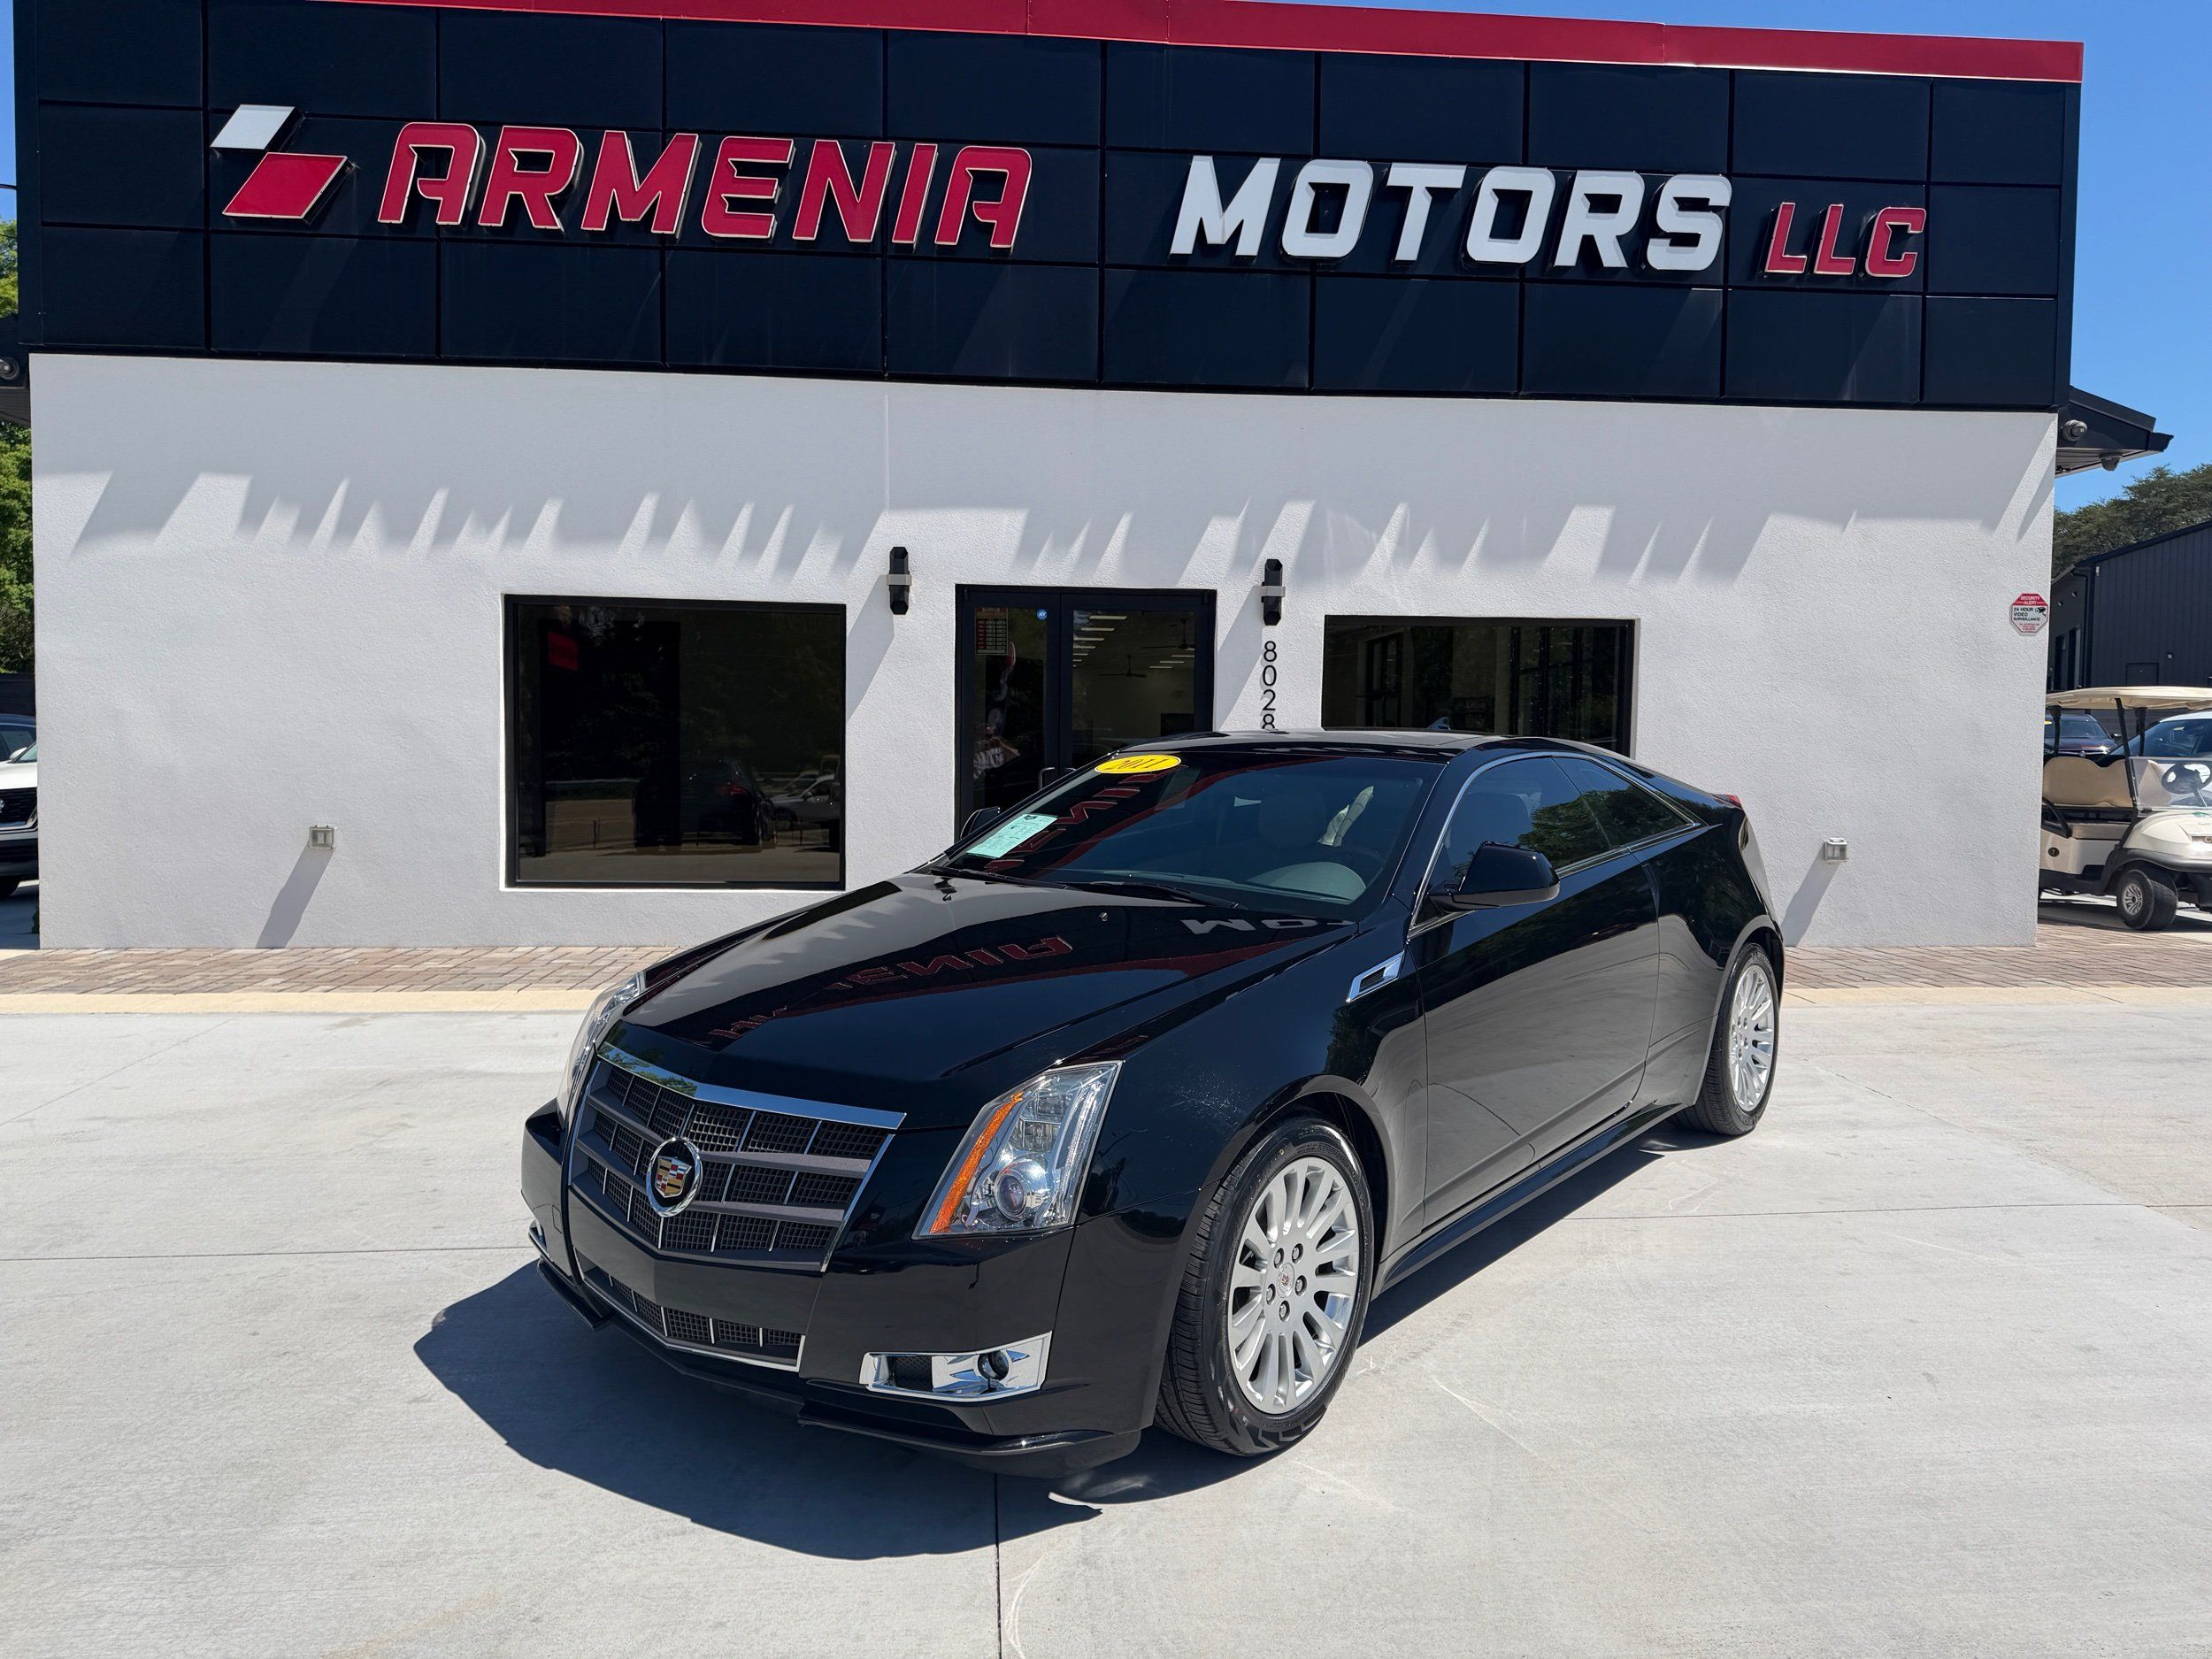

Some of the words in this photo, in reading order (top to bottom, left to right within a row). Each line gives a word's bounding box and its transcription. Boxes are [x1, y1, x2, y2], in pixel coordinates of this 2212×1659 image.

[377, 122, 1033, 249] ARMENIA
[1169, 155, 1732, 271] MOTORS
[1764, 202, 1927, 277] LLC
[1261, 641, 1277, 729] 8028
[1102, 759, 1169, 770] 2011
